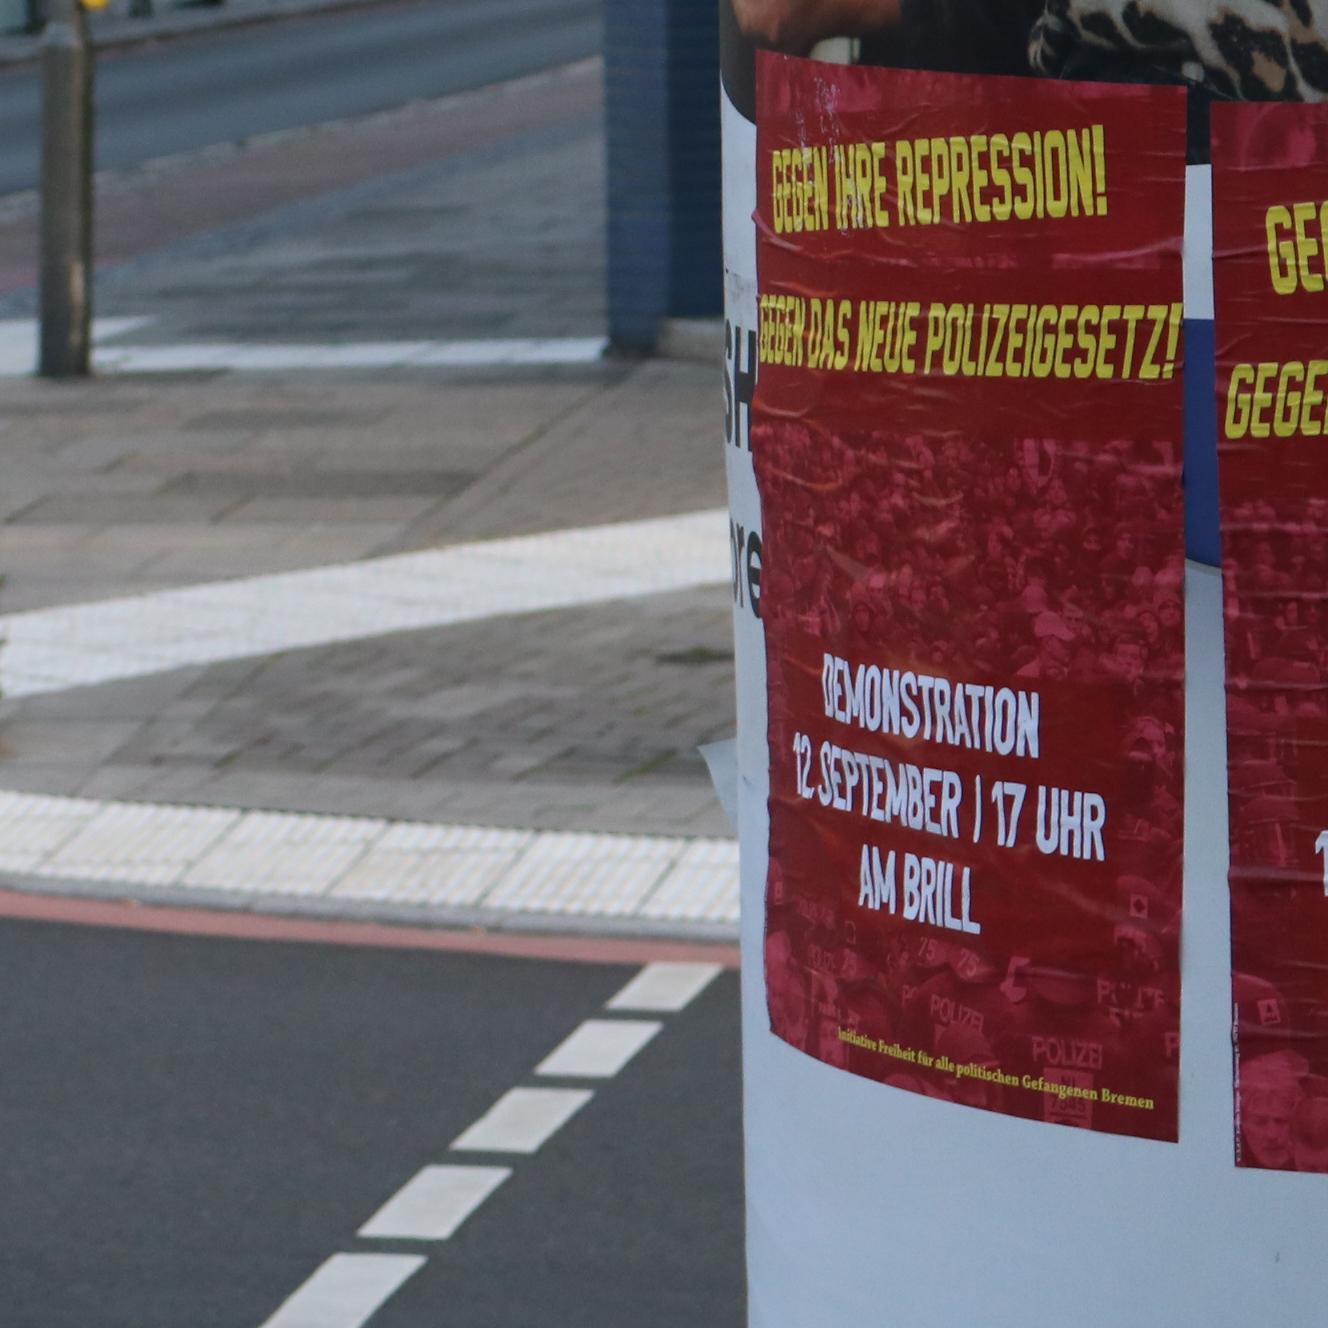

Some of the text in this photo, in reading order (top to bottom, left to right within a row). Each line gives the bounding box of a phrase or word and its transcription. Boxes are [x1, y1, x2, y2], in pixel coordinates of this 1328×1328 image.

[772, 125, 1107, 233] GEGEN IHRE REPRESSION!
[759, 294, 1183, 379] GEGEN DAS NEUE POLIZEIGESETZ!
[821, 653, 1038, 761] DEMONSTRATION
[793, 732, 815, 799] 12.
[818, 738, 961, 838] SEPTEMBER
[992, 781, 1026, 847] 17
[1036, 786, 1105, 861] UHR
[858, 844, 980, 934] AM BRILL
